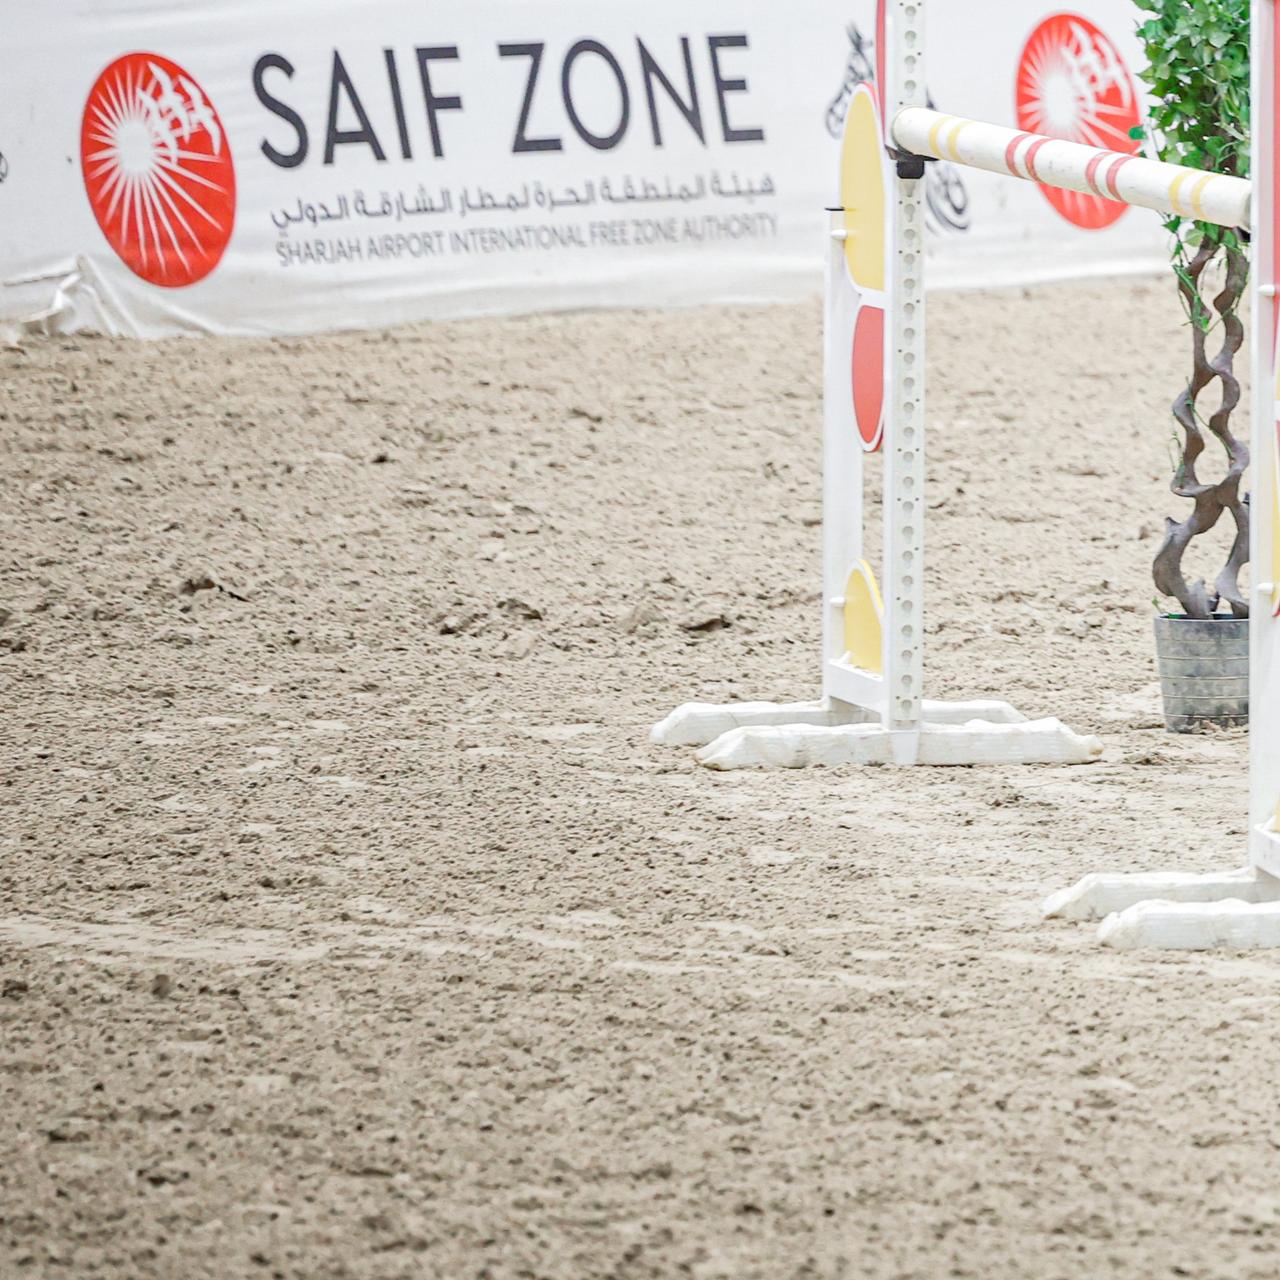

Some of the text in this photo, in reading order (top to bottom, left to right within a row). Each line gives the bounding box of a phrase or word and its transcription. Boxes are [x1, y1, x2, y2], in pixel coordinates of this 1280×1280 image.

[251, 33, 765, 169] SAIF ZONE
[275, 213, 776, 267] SHARJAH AIRPORT INTERNATIONAL FREE ZONE AUTHORITY
